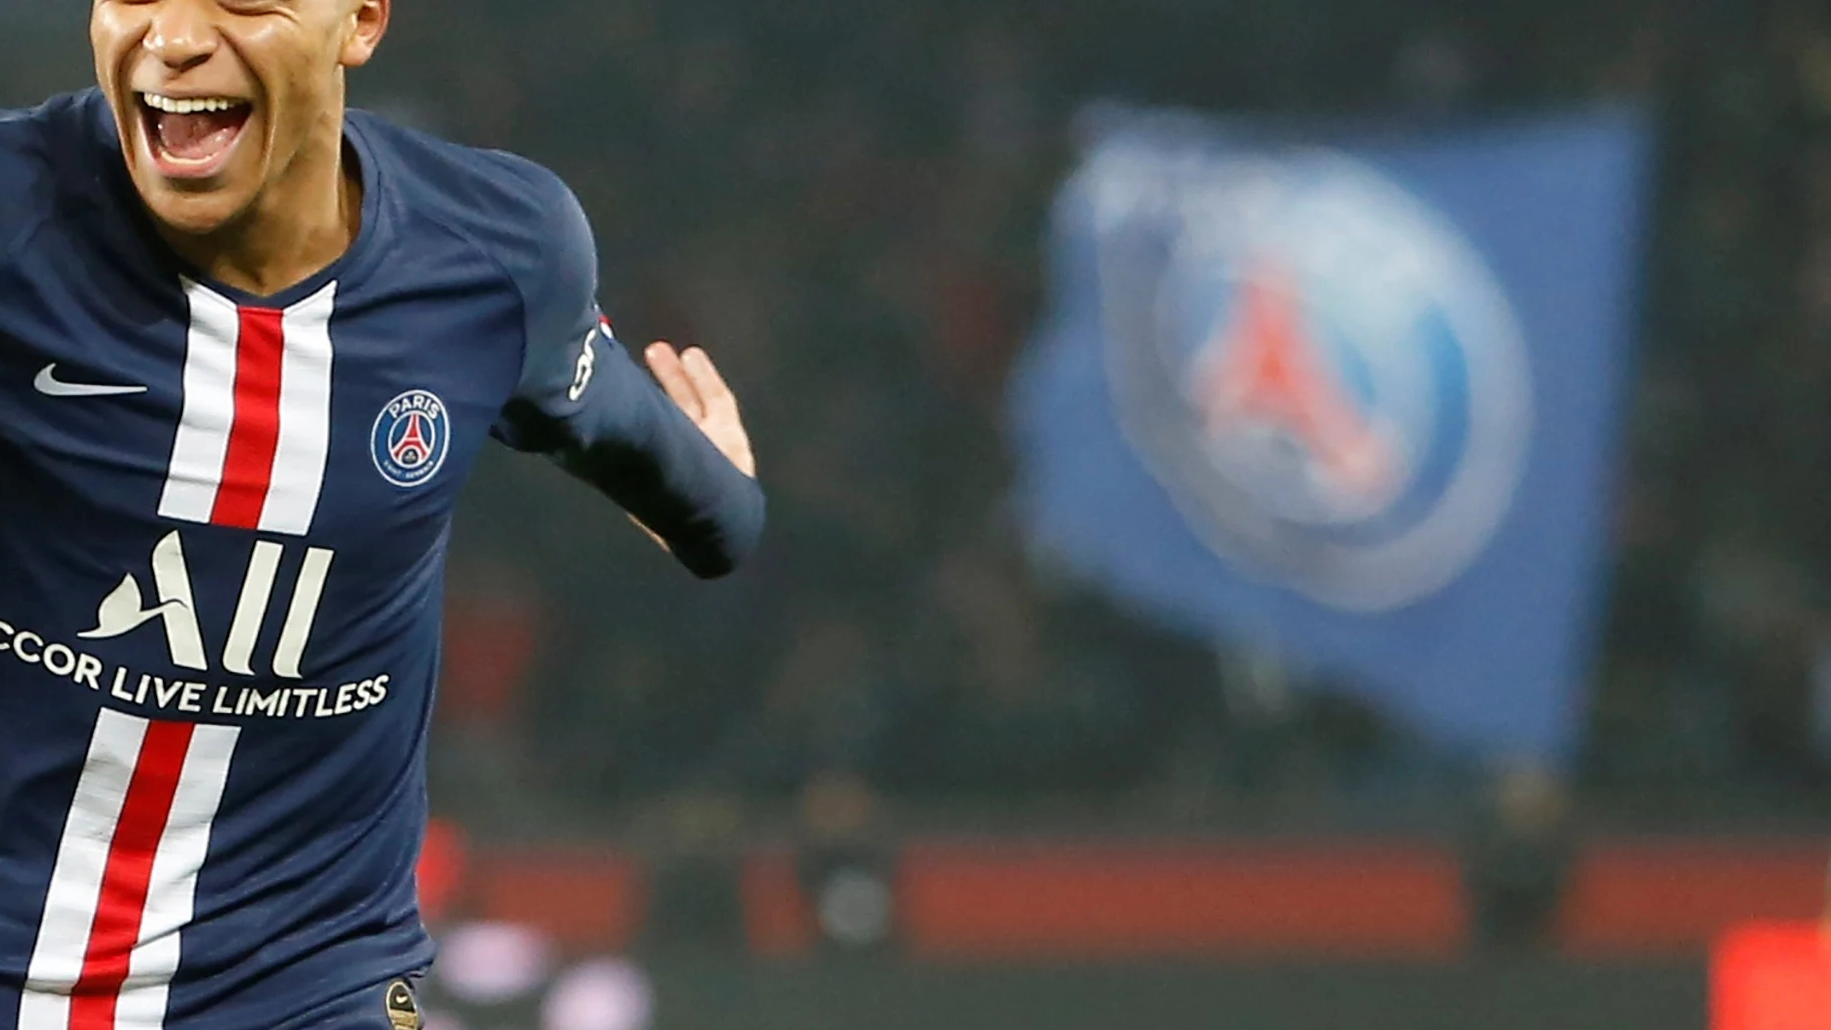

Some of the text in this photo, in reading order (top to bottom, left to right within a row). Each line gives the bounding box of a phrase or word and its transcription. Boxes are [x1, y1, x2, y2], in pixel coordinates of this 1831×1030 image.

[388, 394, 441, 420] PARIS
[110, 665, 208, 714] LIVE
[211, 673, 391, 719] LIMITLESS
